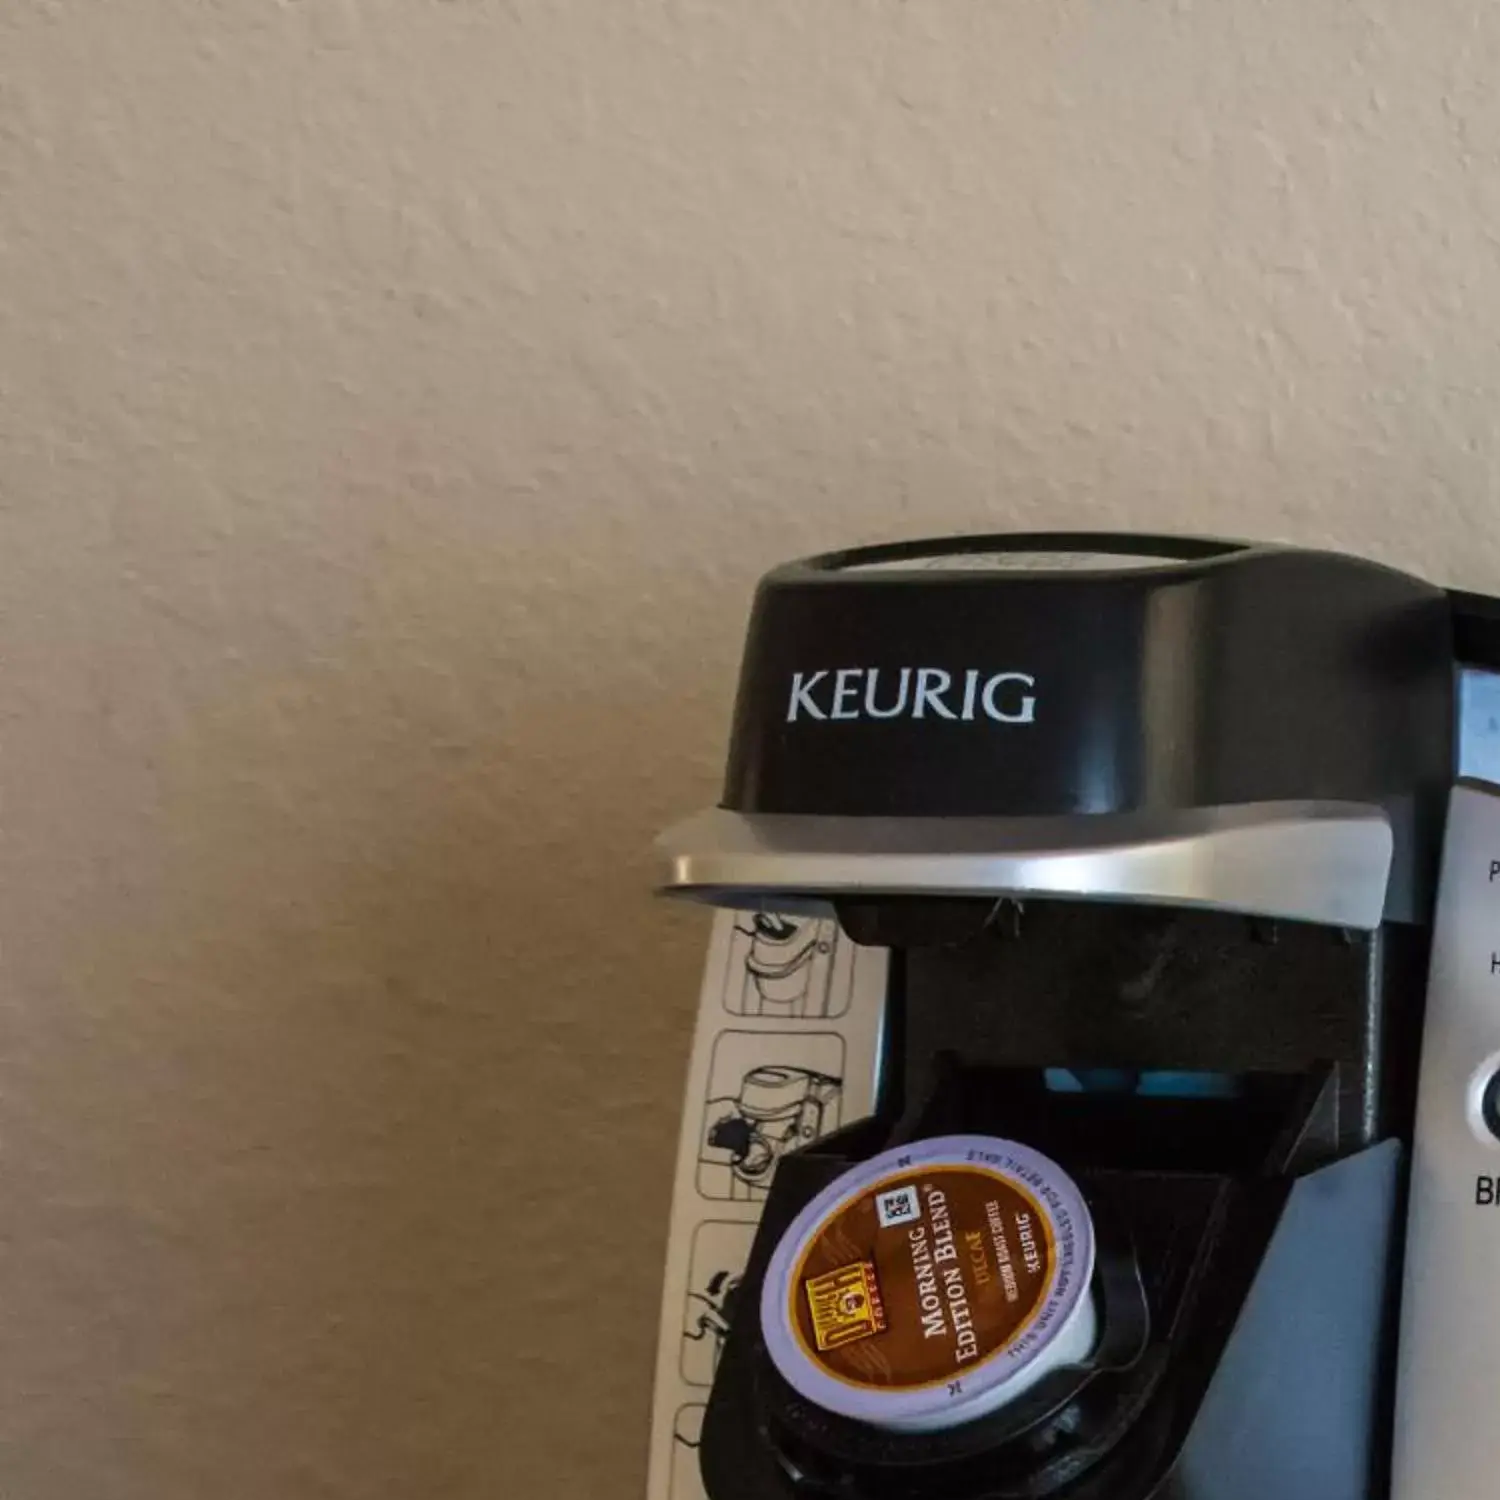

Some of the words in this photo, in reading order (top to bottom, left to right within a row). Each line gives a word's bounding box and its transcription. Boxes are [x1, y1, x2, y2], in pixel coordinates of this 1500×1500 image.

[787, 667, 1036, 723] KEURIG
[1015, 1212, 1041, 1274] KEURIG
[908, 1227, 947, 1340] MORNING
[943, 1267, 979, 1364] EDITION
